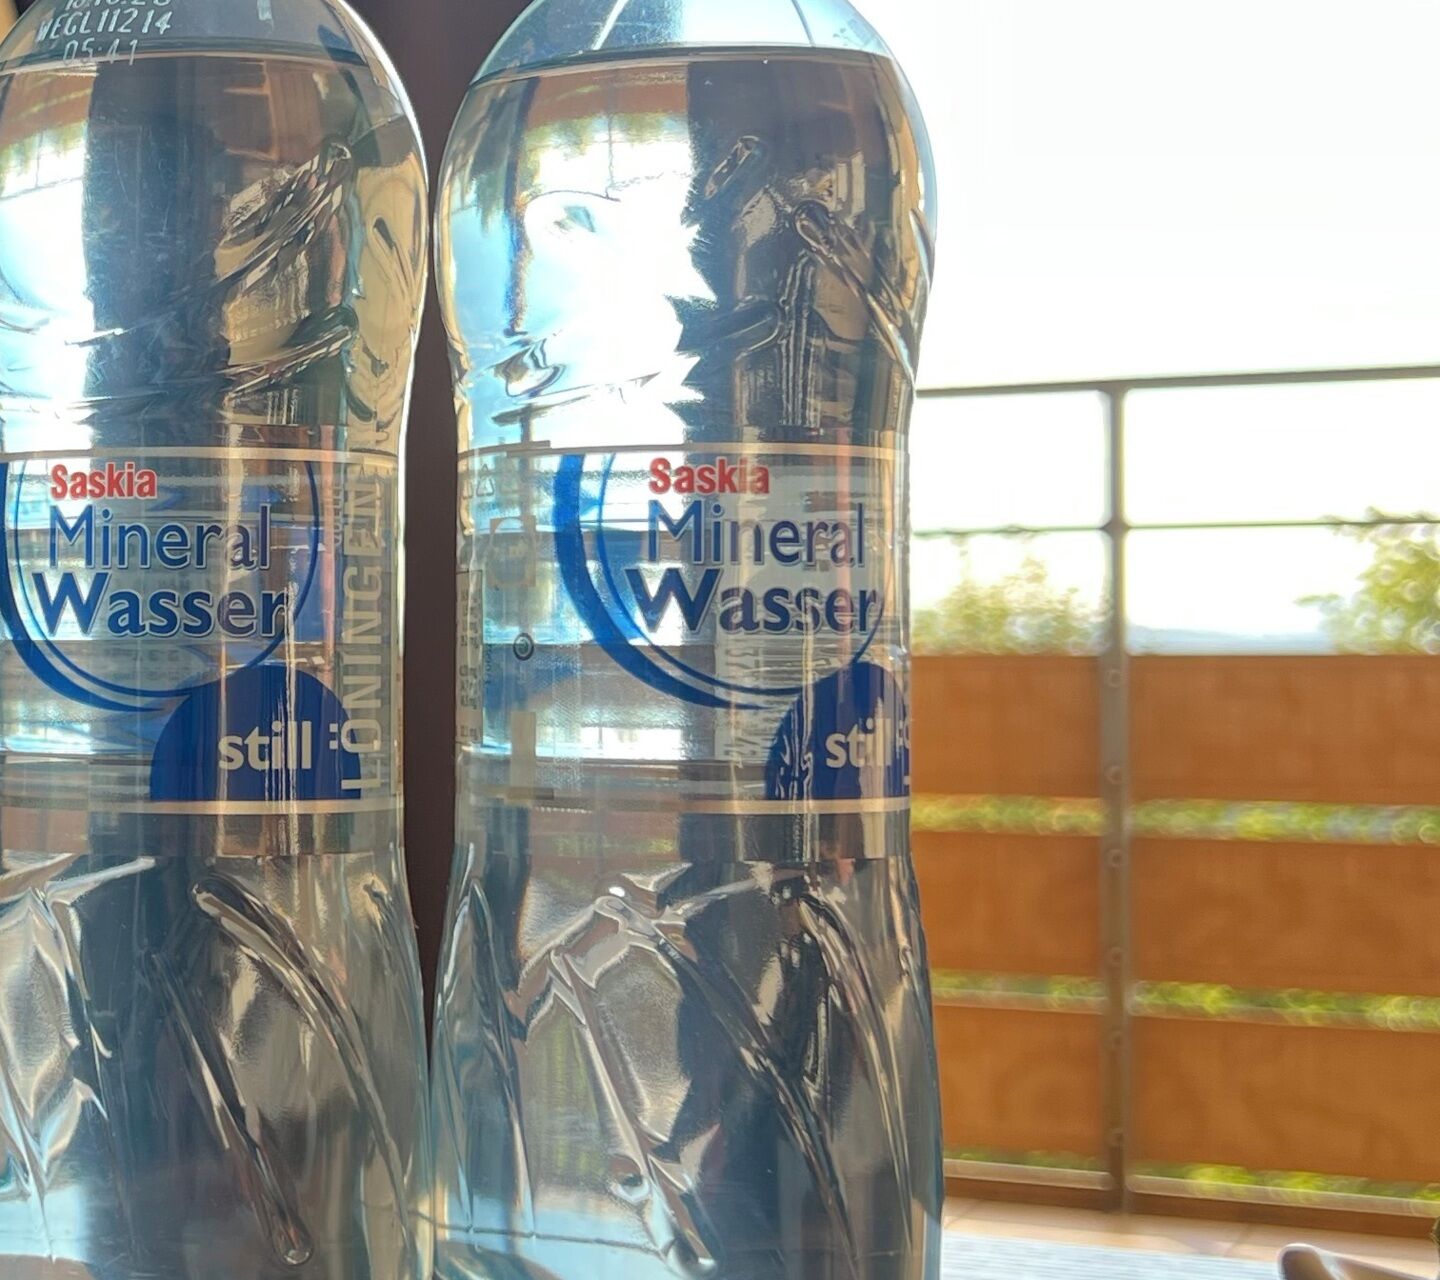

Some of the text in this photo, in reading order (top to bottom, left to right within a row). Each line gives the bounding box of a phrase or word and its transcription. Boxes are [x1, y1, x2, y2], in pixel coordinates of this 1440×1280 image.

[51, 462, 157, 500] Saskia
[648, 457, 770, 495] Saskia
[49, 504, 272, 570] Mineral
[647, 499, 865, 568] Mineral
[33, 572, 288, 637] Wasser
[624, 568, 883, 636] Wasser
[218, 721, 312, 771] still
